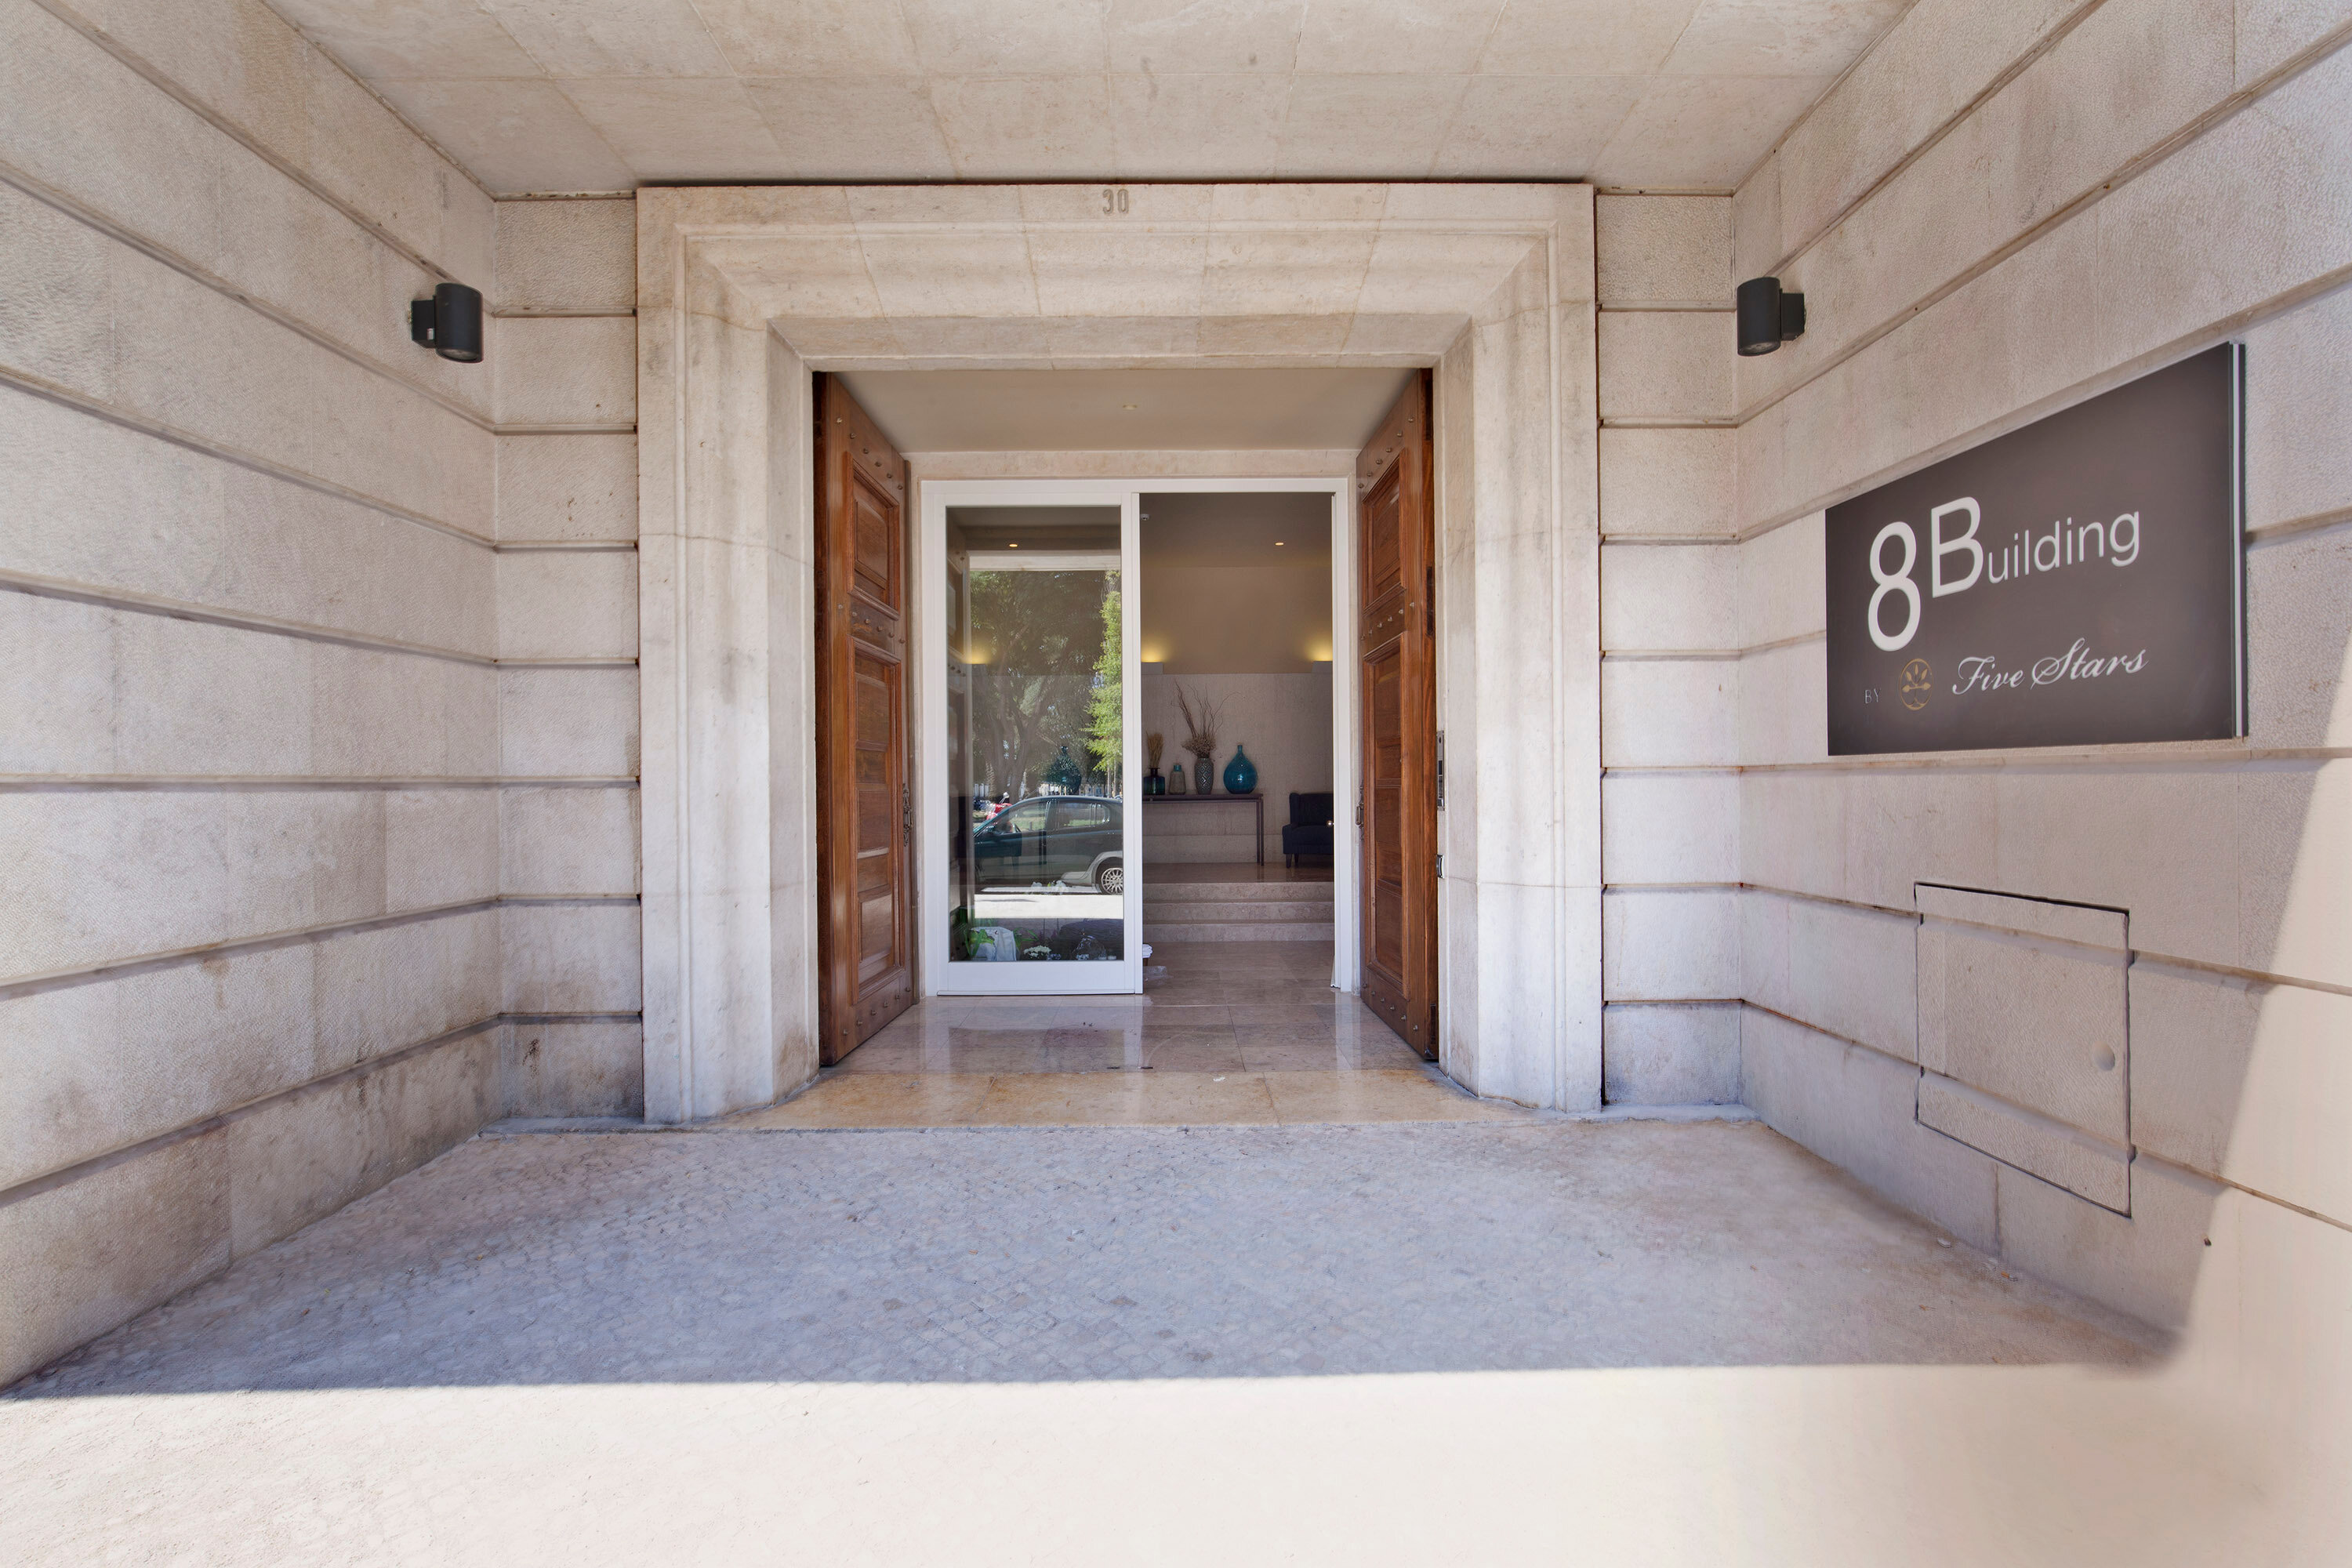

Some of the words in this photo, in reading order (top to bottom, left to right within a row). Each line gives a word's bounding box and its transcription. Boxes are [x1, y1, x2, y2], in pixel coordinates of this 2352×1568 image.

[1102, 189, 1129, 215] 30
[1867, 521, 1921, 652] 8
[1931, 496, 2140, 598] Building
[1864, 688, 1881, 704] BY
[1951, 656, 2025, 695] Five
[2031, 637, 2149, 689] Stars
